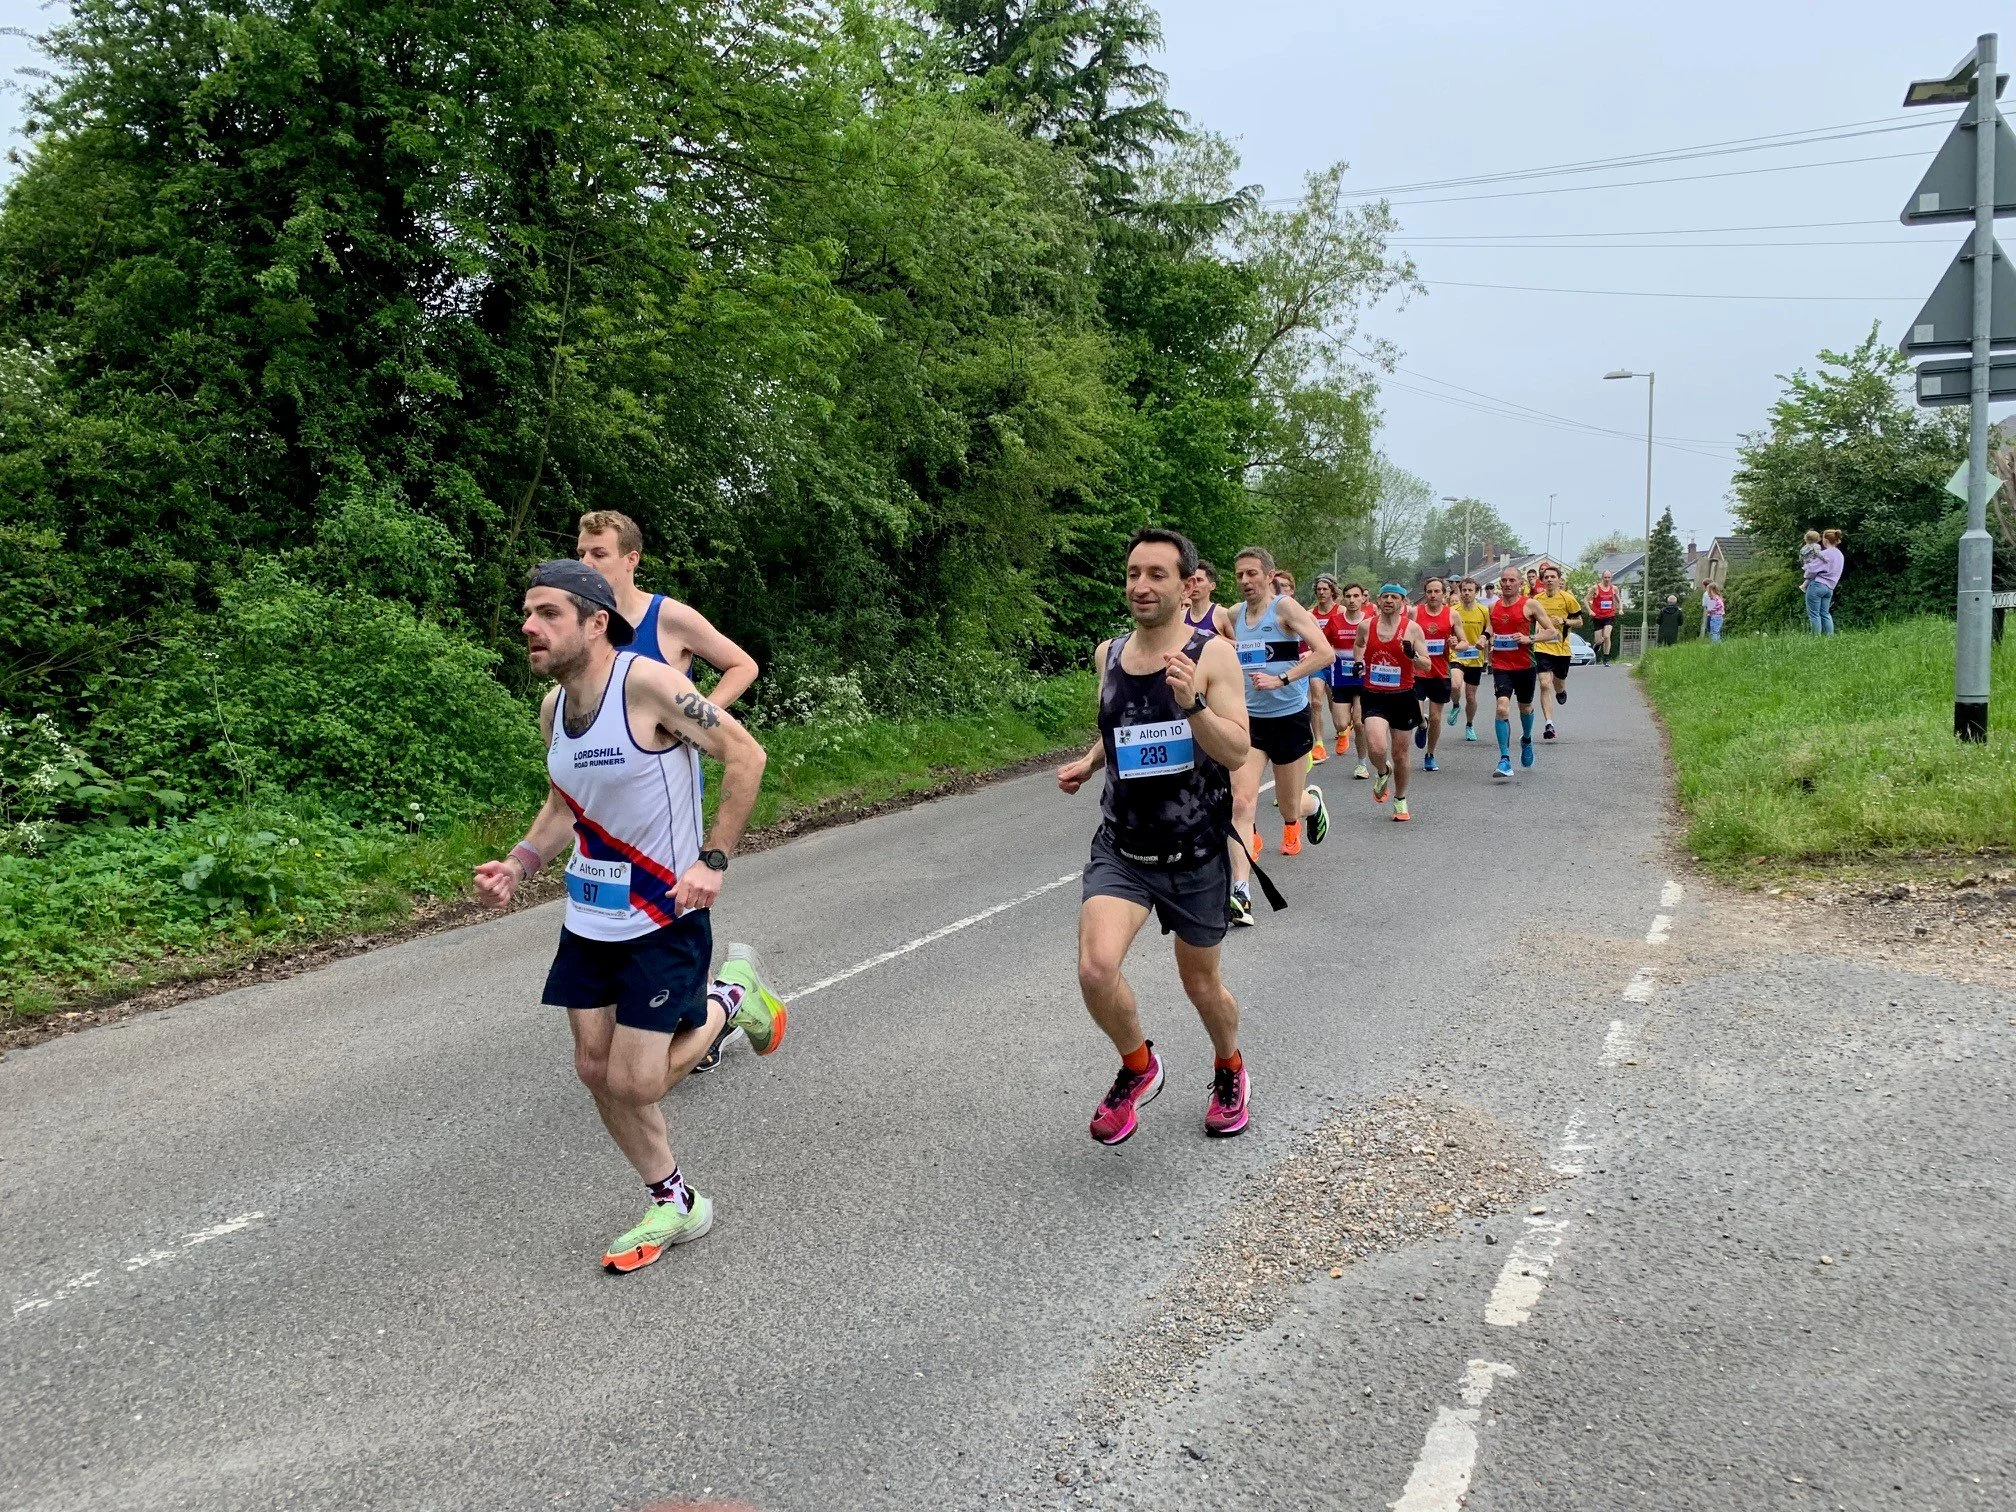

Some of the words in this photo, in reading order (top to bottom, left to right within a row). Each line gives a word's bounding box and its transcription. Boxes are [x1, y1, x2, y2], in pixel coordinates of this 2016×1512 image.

[1242, 652, 1252, 663] 196
[1140, 729, 1167, 740] Alton
[1170, 726, 1182, 736] 10
[574, 747, 623, 760] LORDSHILL
[1140, 745, 1168, 766] 233
[574, 760, 588, 769] ROAD
[589, 758, 626, 767] RUNNERS
[580, 862, 606, 877] Alton
[610, 867, 622, 878] 10
[583, 882, 598, 903] 97
